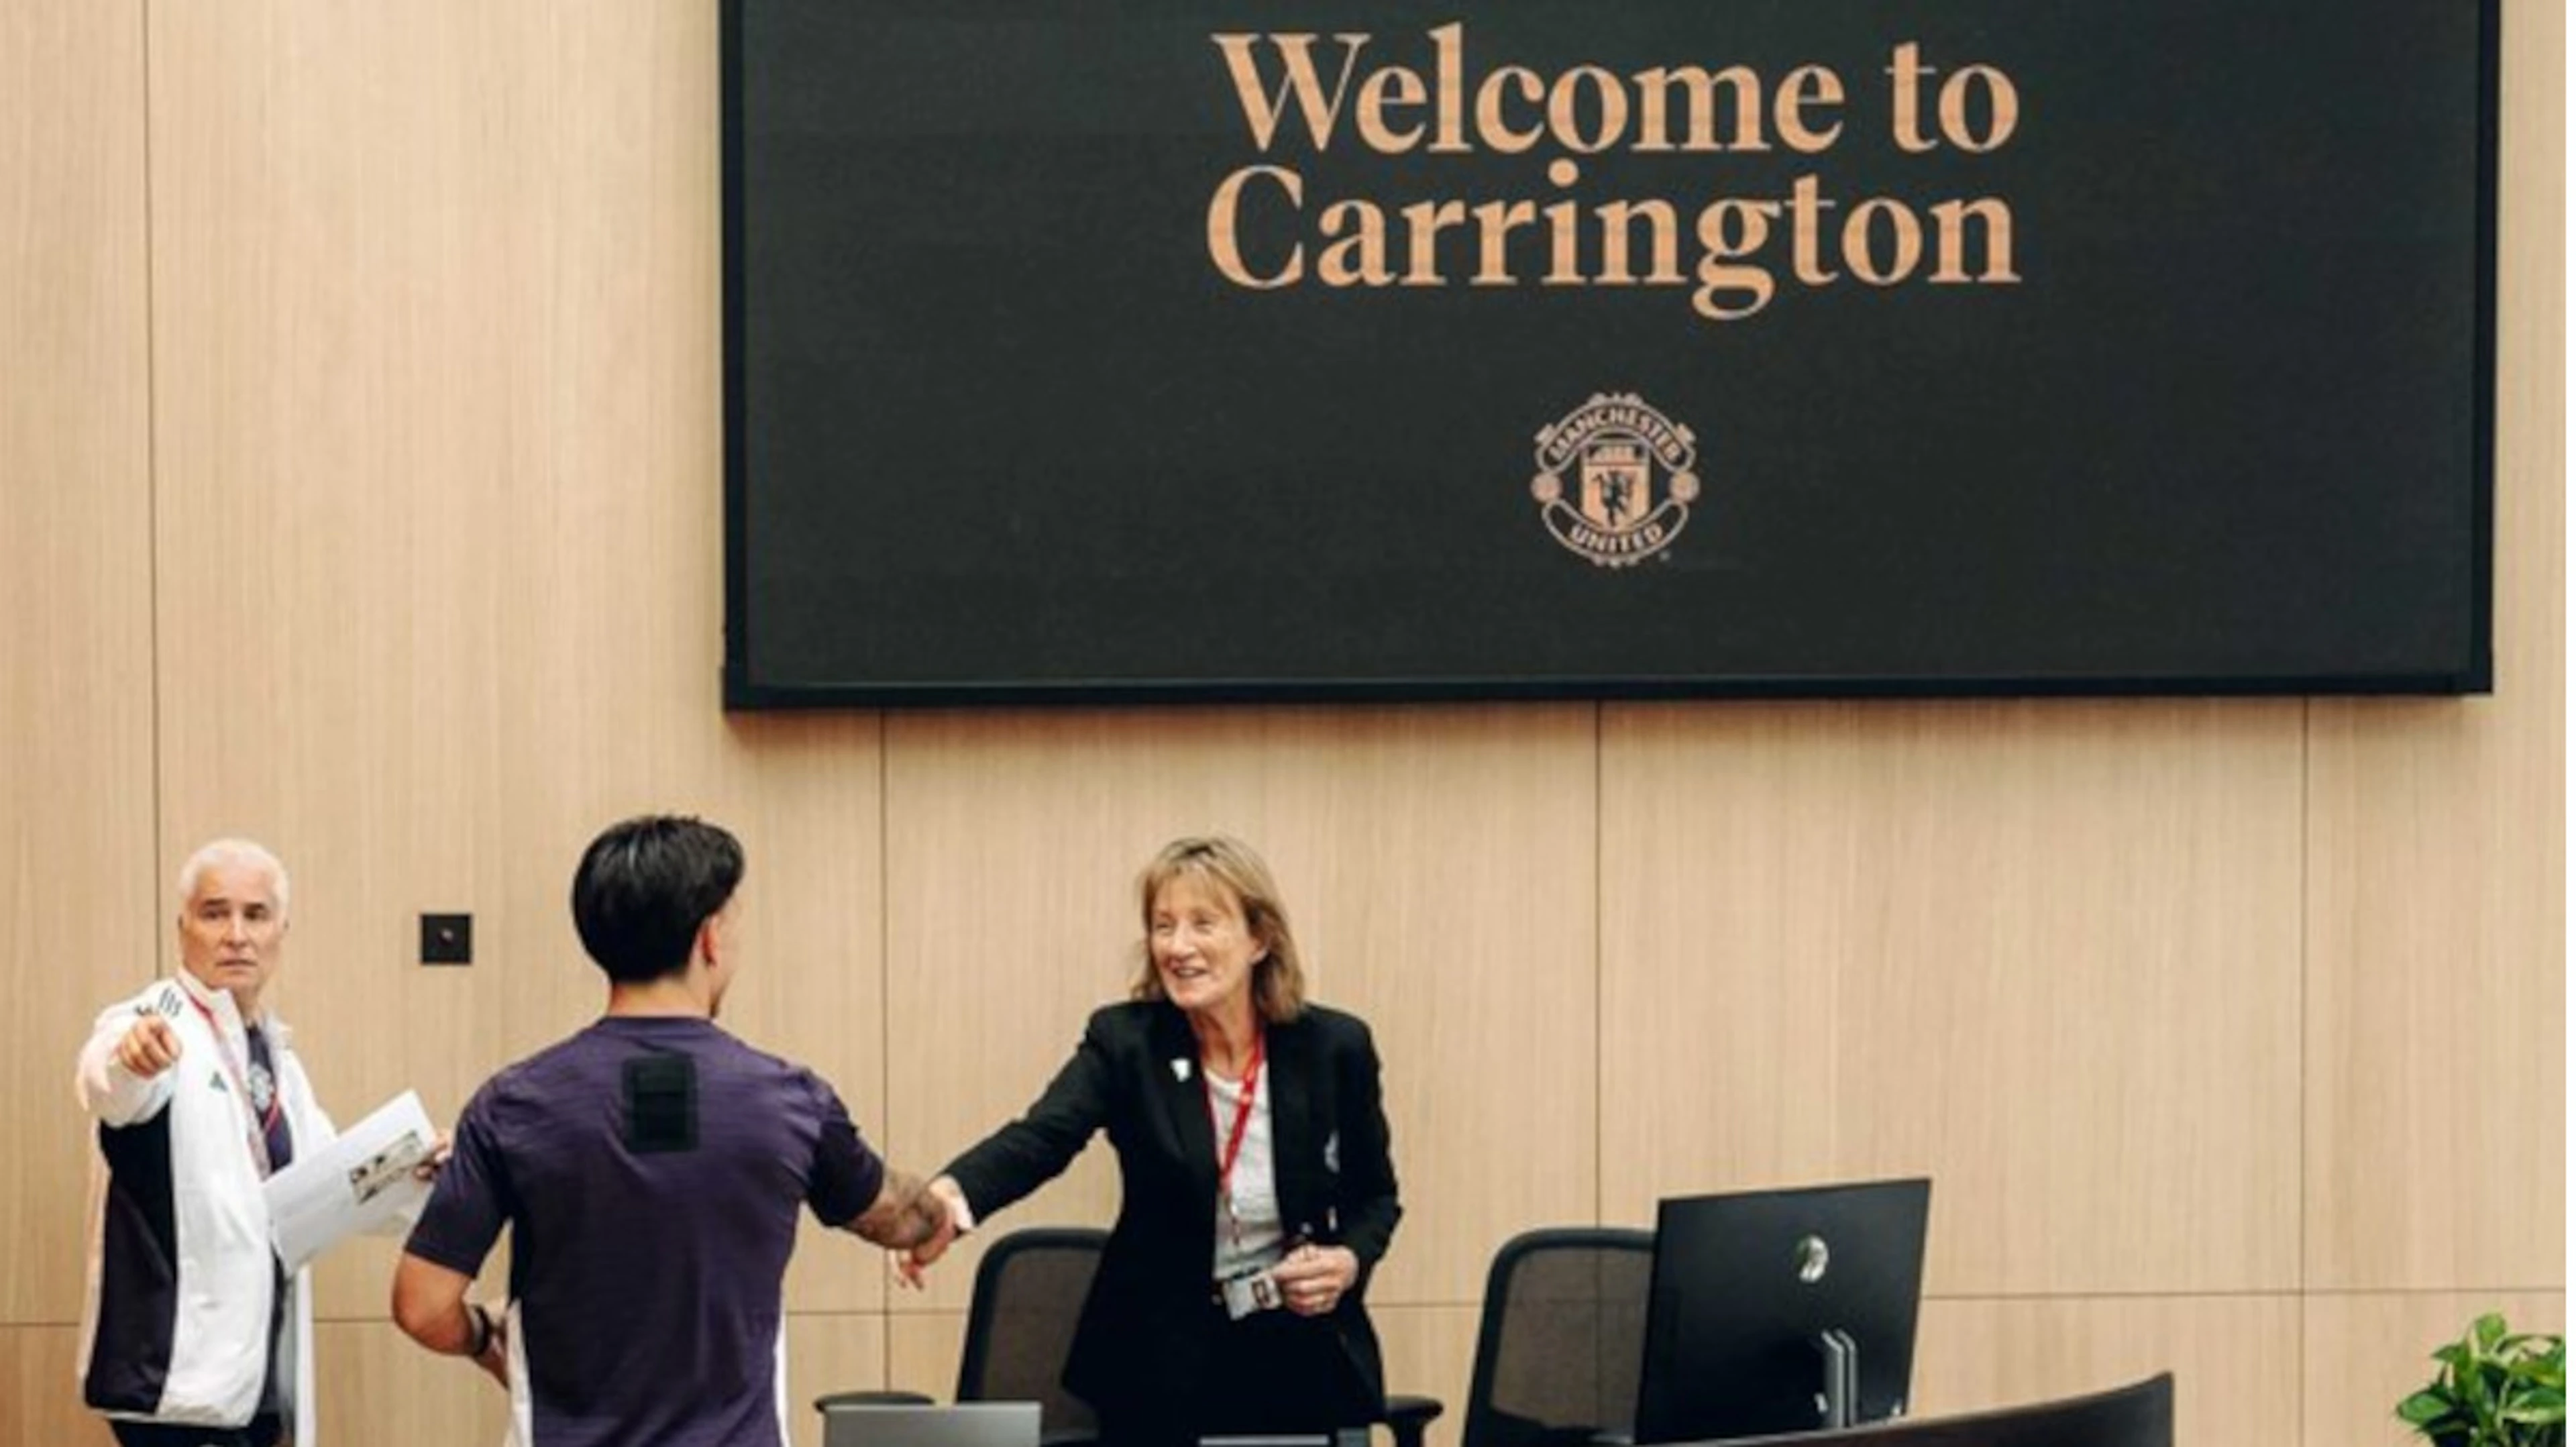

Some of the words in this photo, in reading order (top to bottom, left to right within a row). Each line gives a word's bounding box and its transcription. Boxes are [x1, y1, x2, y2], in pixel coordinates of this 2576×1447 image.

[1212, 23, 1845, 154] Welcome
[1886, 42, 2019, 152] to
[1207, 158, 2021, 320] Carrington
[1548, 407, 1681, 460] MANCHESTER
[1570, 524, 1663, 553] UNITED
